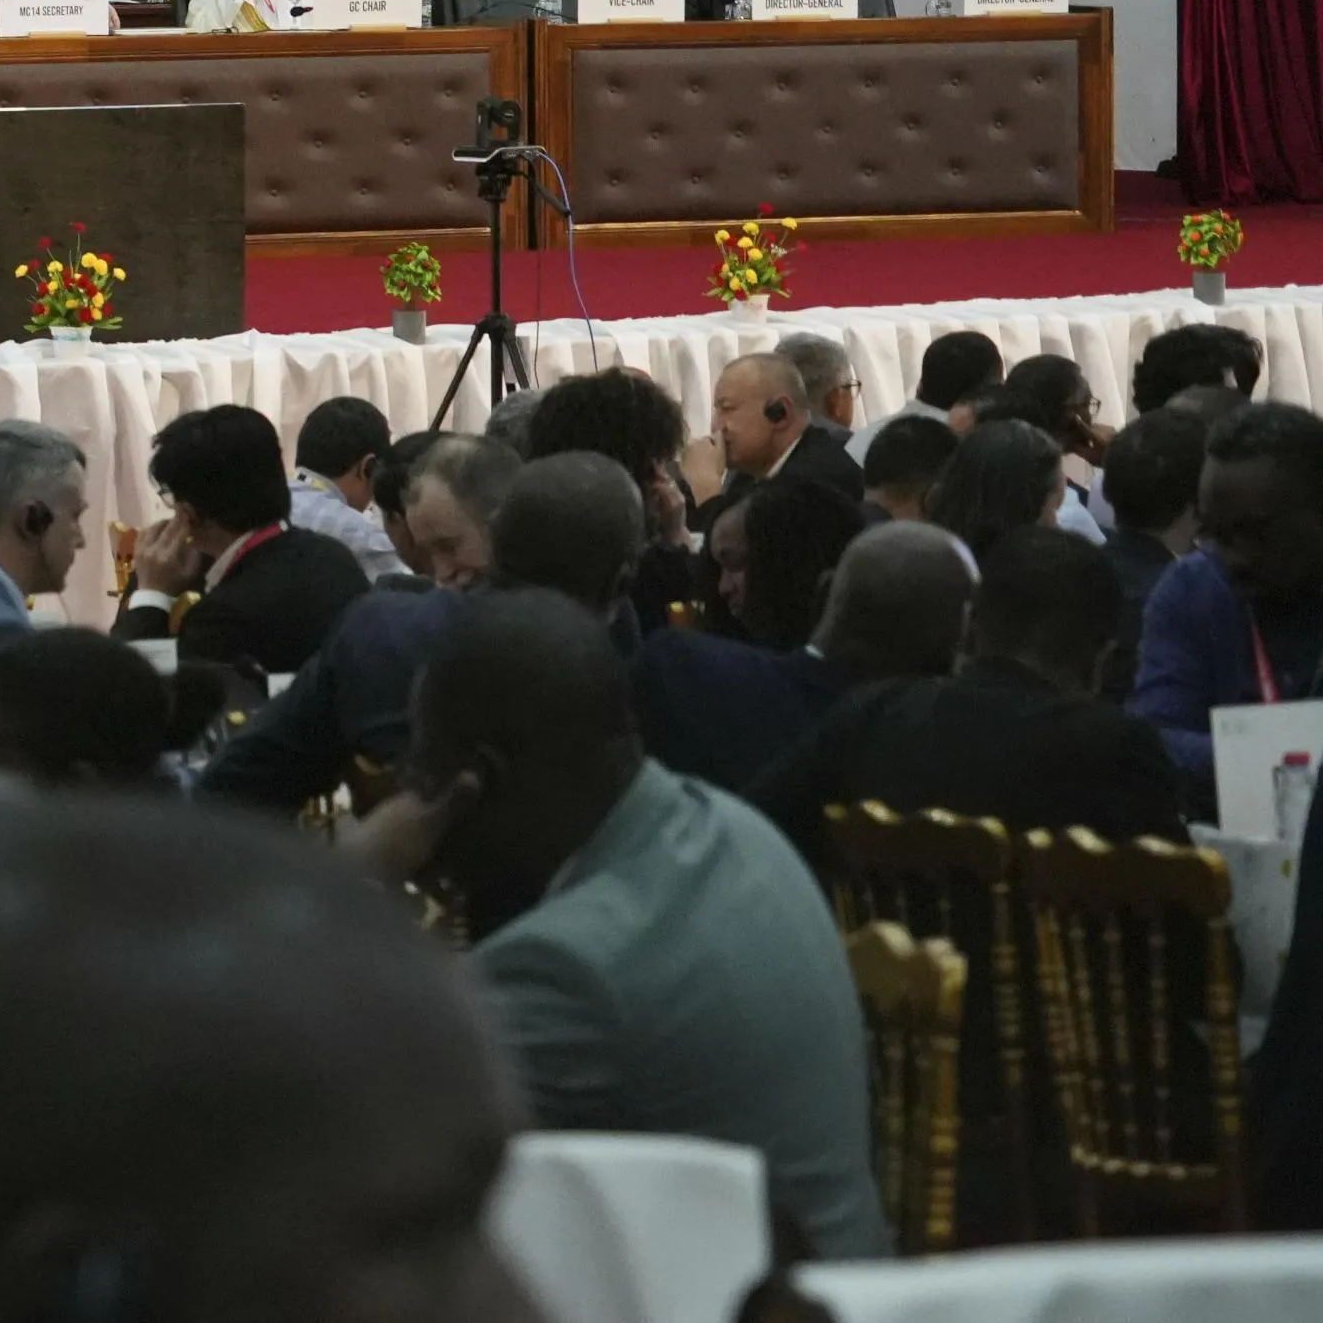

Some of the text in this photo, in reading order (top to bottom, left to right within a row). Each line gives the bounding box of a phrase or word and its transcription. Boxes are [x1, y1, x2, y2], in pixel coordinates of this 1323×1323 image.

[20, 6, 83, 16] MC14 SECRETARY
[350, 1, 386, 12] GC CHAIR
